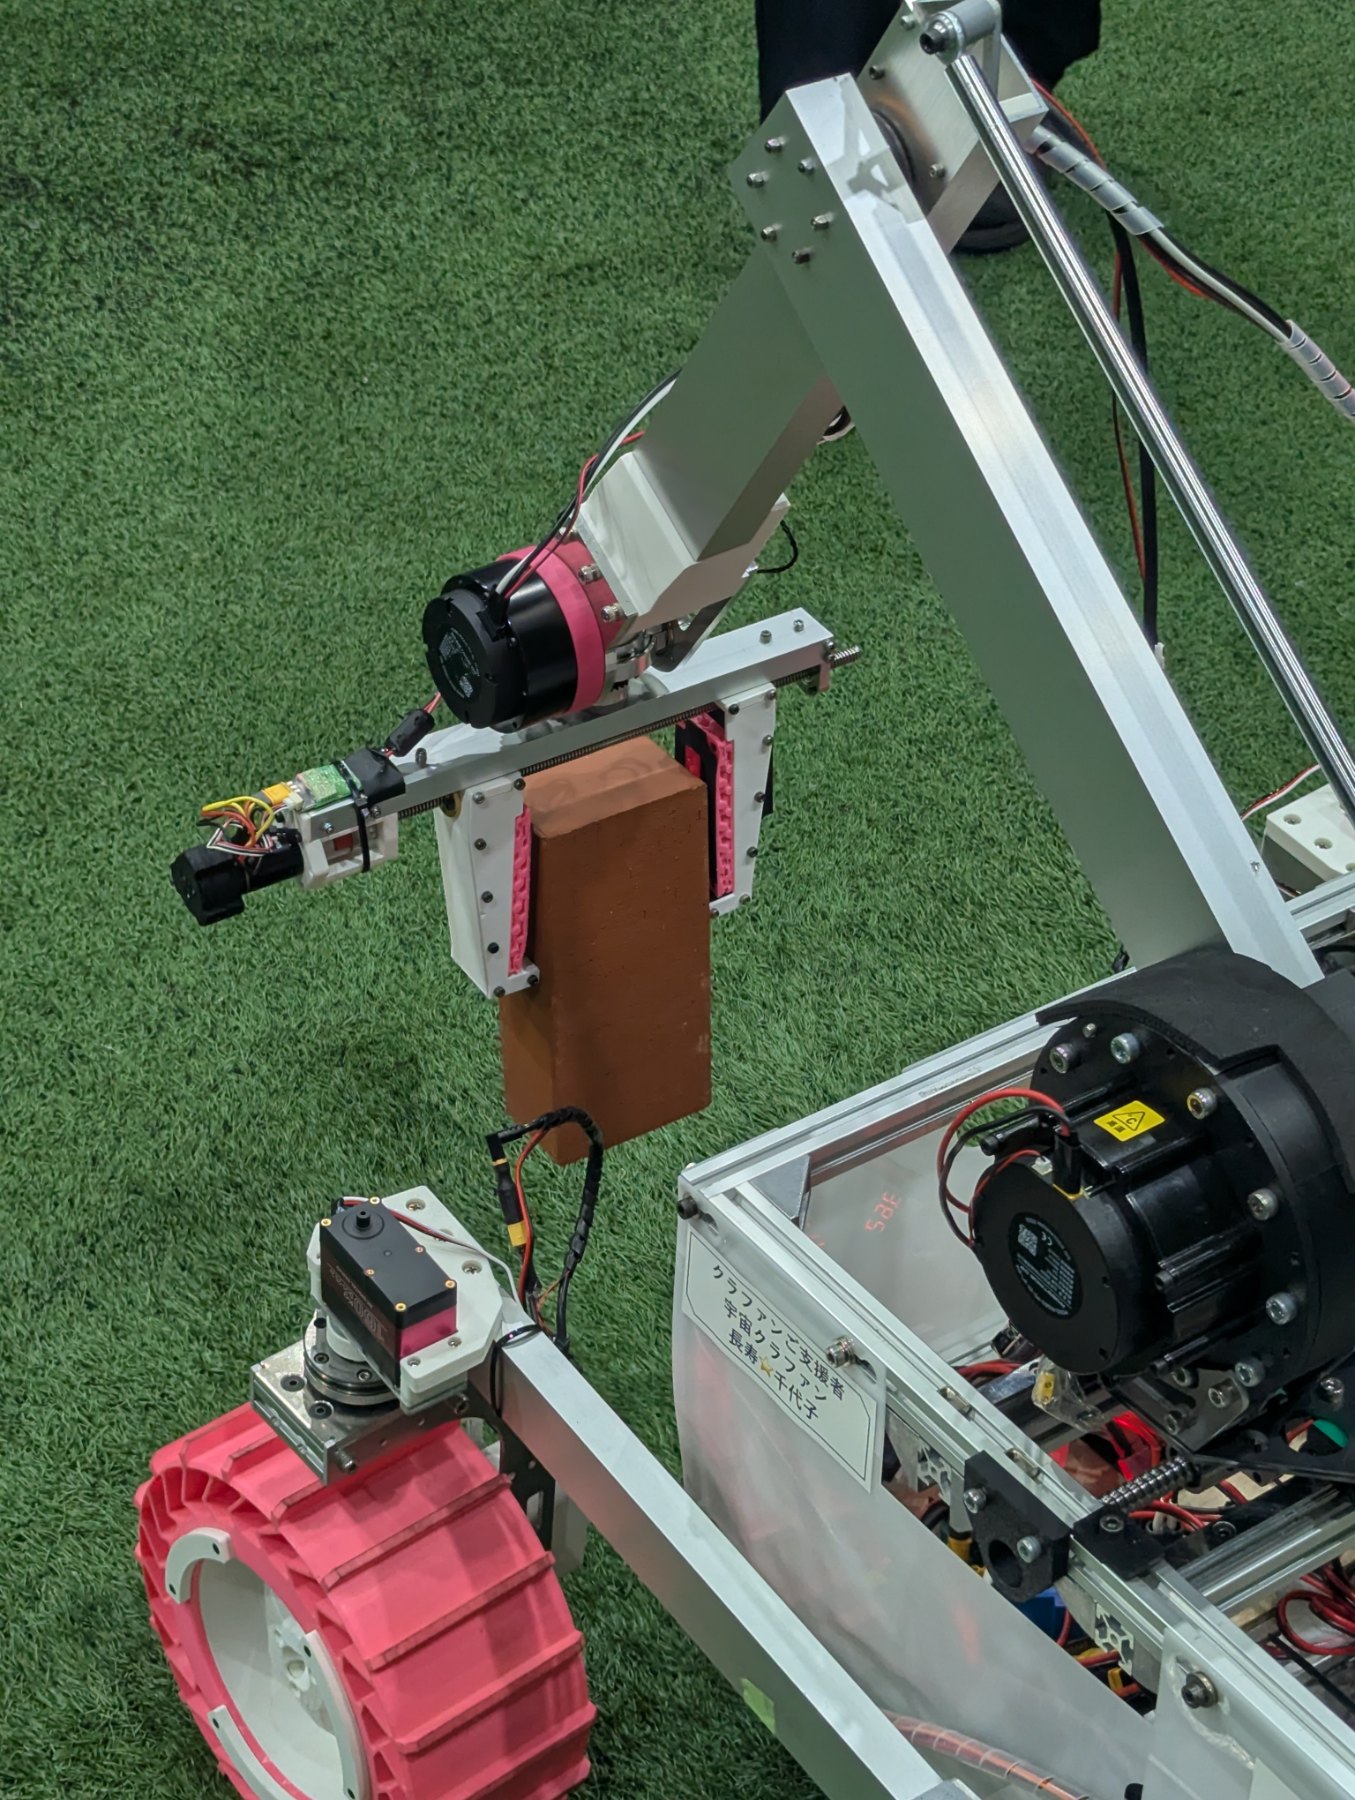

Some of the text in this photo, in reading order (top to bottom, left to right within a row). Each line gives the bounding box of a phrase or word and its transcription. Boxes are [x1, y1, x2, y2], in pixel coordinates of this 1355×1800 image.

[713, 1265, 845, 1400] クラファンご支援者
[724, 1298, 827, 1400] 宇宙クラファン
